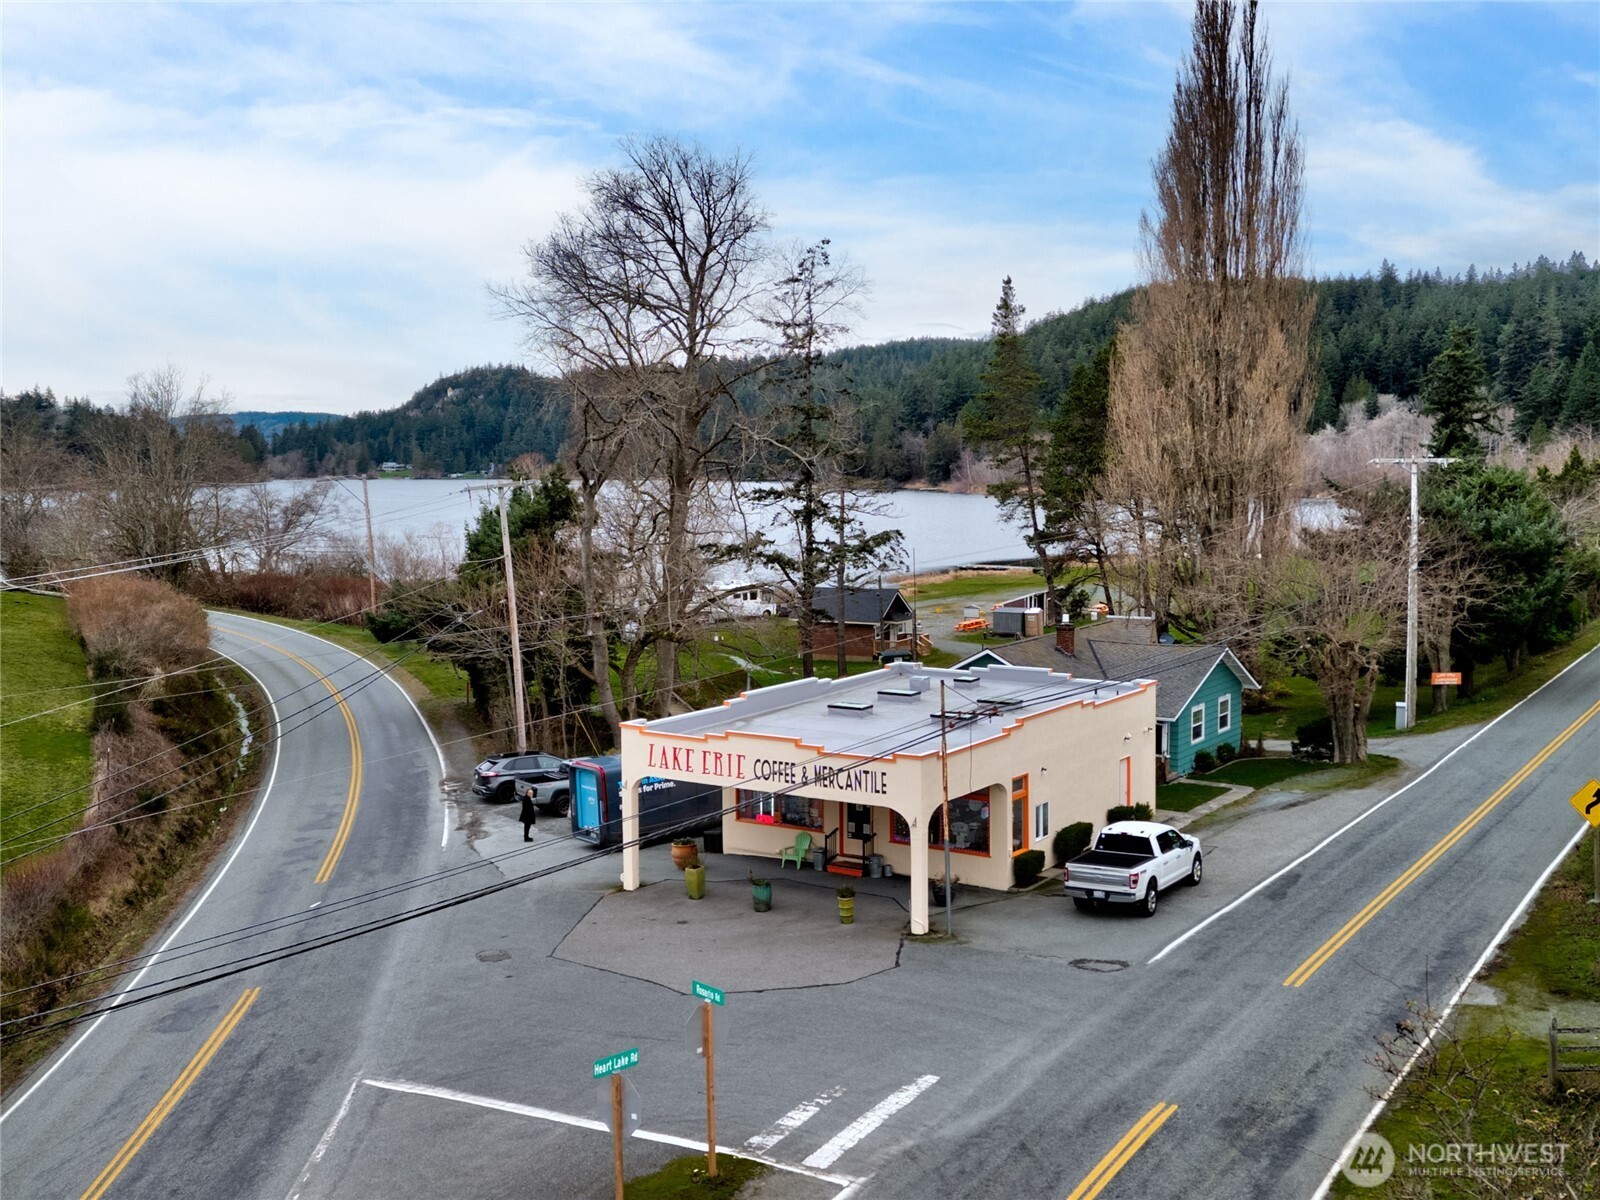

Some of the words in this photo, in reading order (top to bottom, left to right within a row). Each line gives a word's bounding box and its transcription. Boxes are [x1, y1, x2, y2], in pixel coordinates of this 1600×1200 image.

[648, 743, 694, 773] LAKE
[701, 750, 746, 780] ERIE
[753, 758, 796, 785] COFFEE
[801, 765, 809, 786] &
[813, 764, 888, 795] MERCANTILE
[642, 784, 654, 793] for
[594, 1059, 613, 1076] Heart
[613, 1055, 629, 1069] Lake
[630, 1051, 638, 1064] Rd
